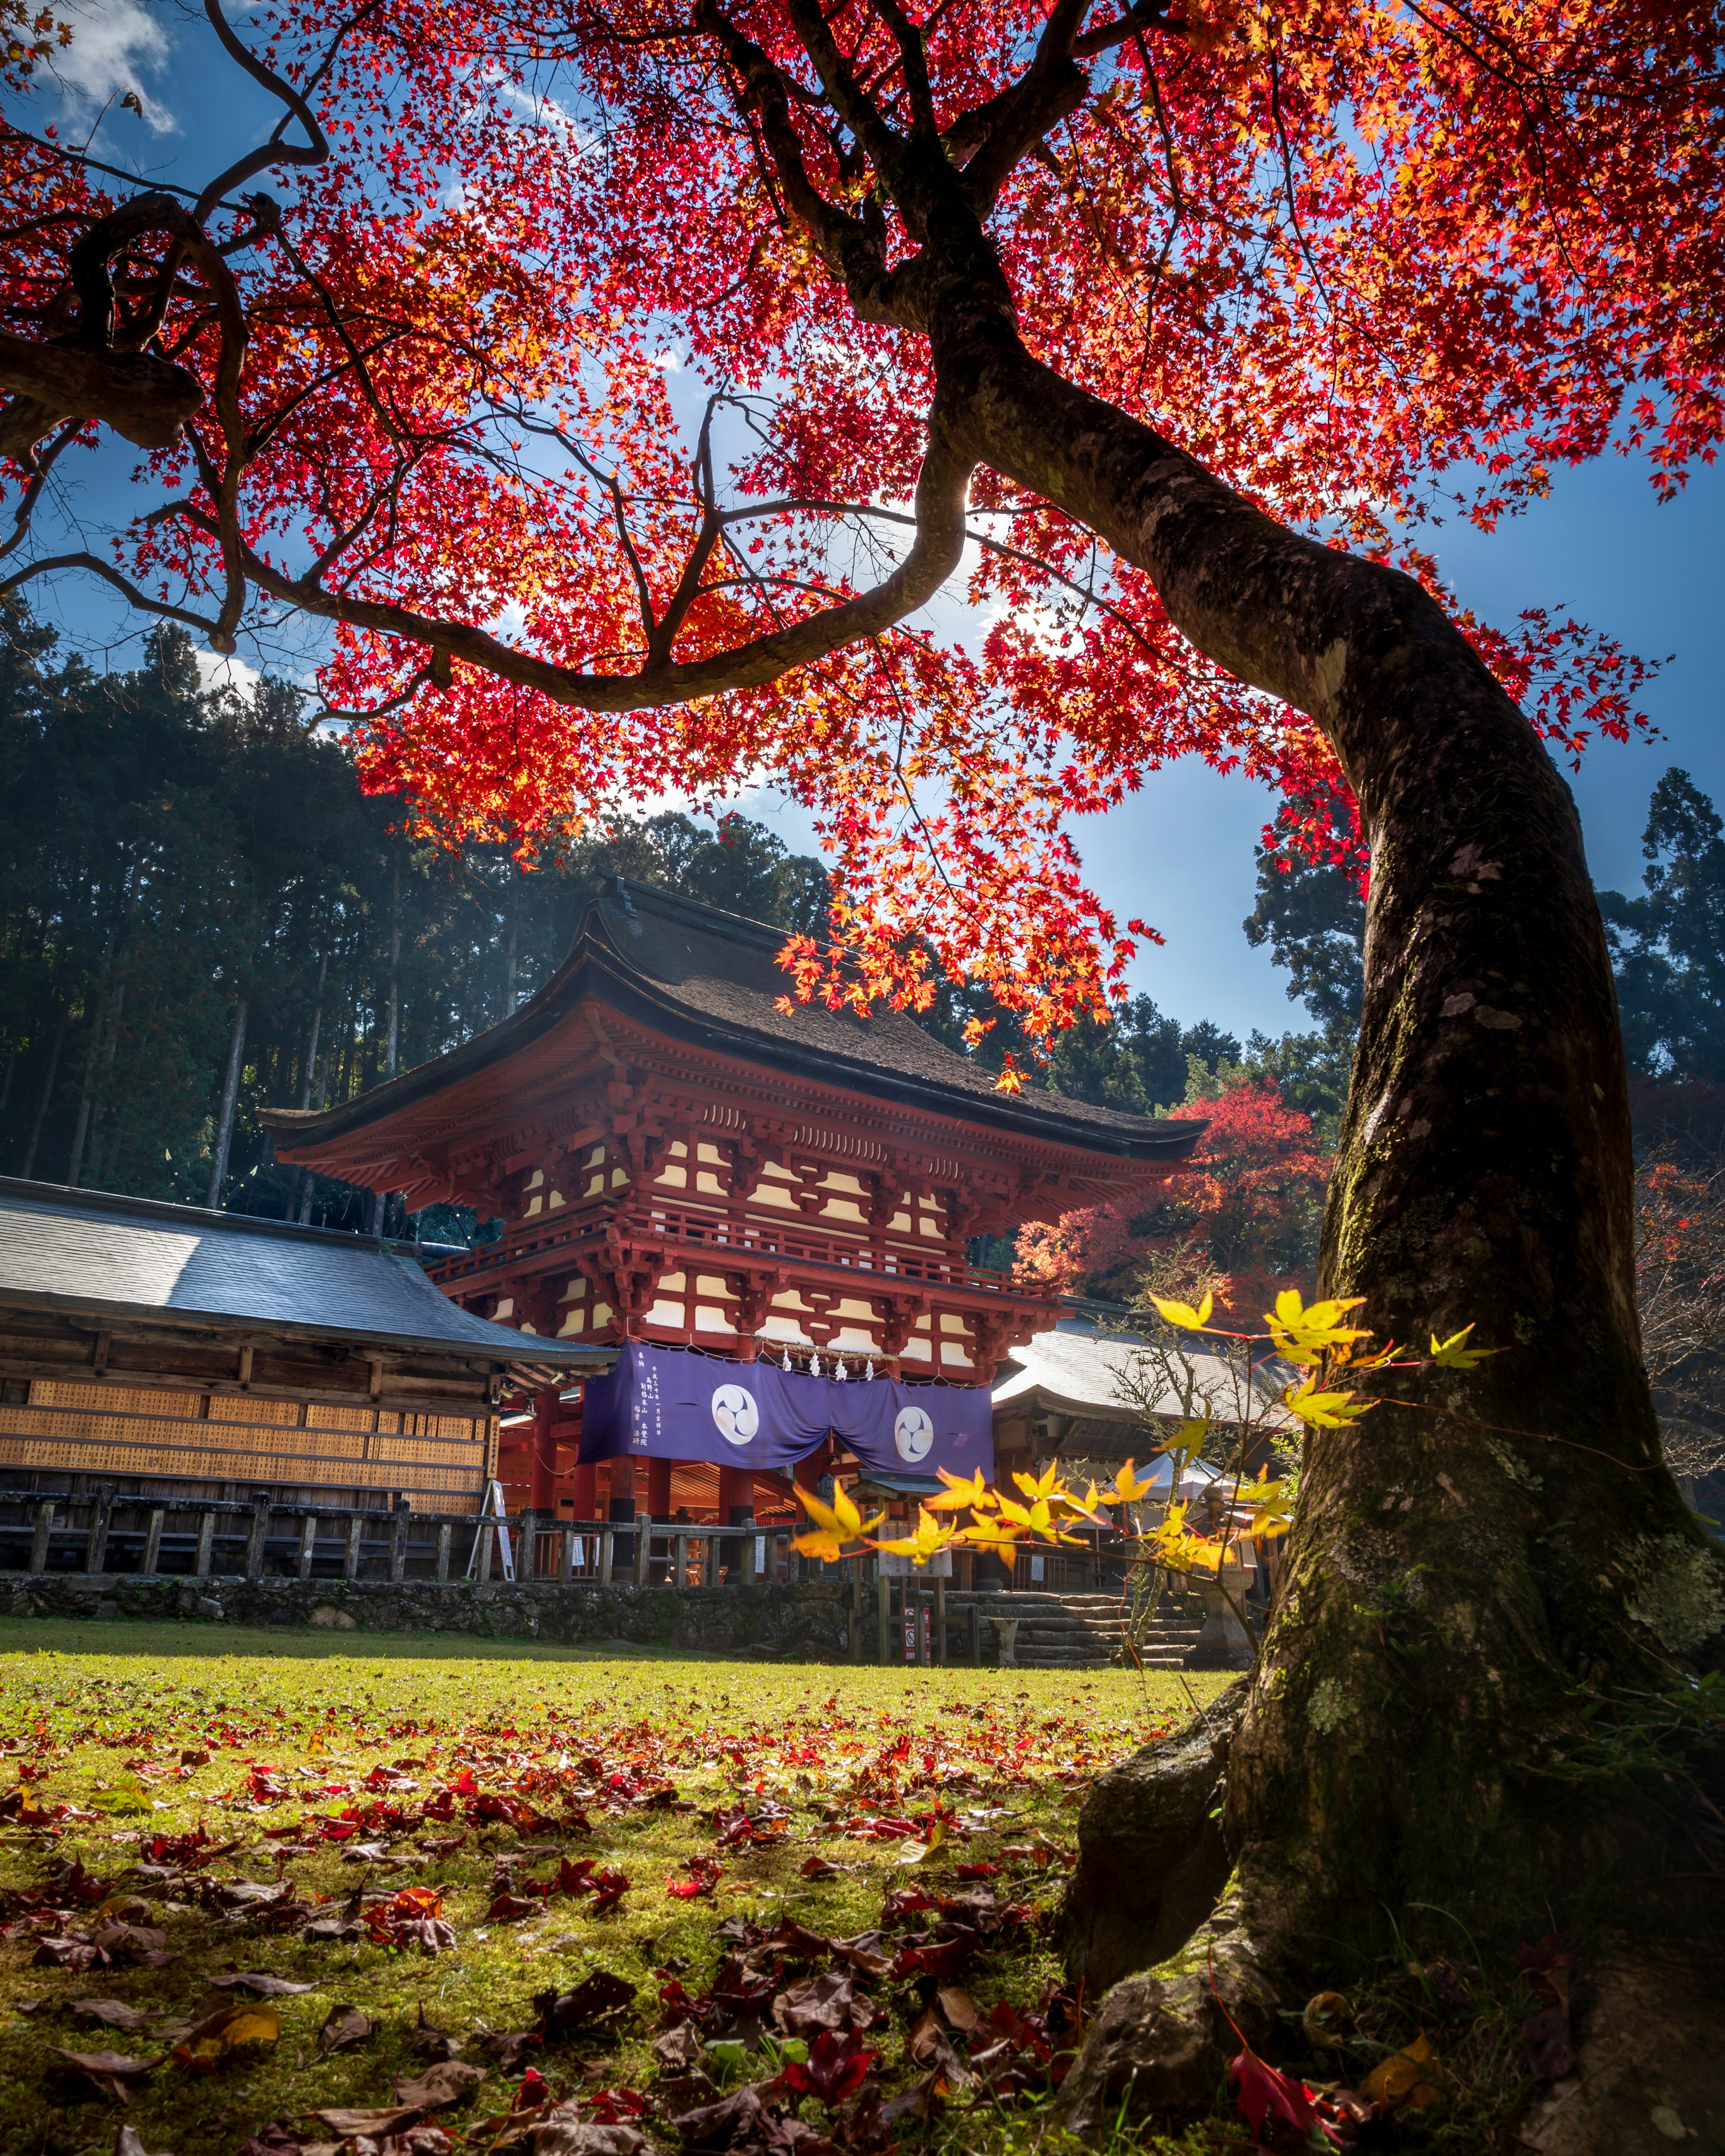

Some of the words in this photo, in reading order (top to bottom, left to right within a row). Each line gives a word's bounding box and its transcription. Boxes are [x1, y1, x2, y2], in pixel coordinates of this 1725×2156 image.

[638, 1352, 644, 1367] 奉納
[652, 1366, 661, 1436] 平成三十年一月吉祥日
